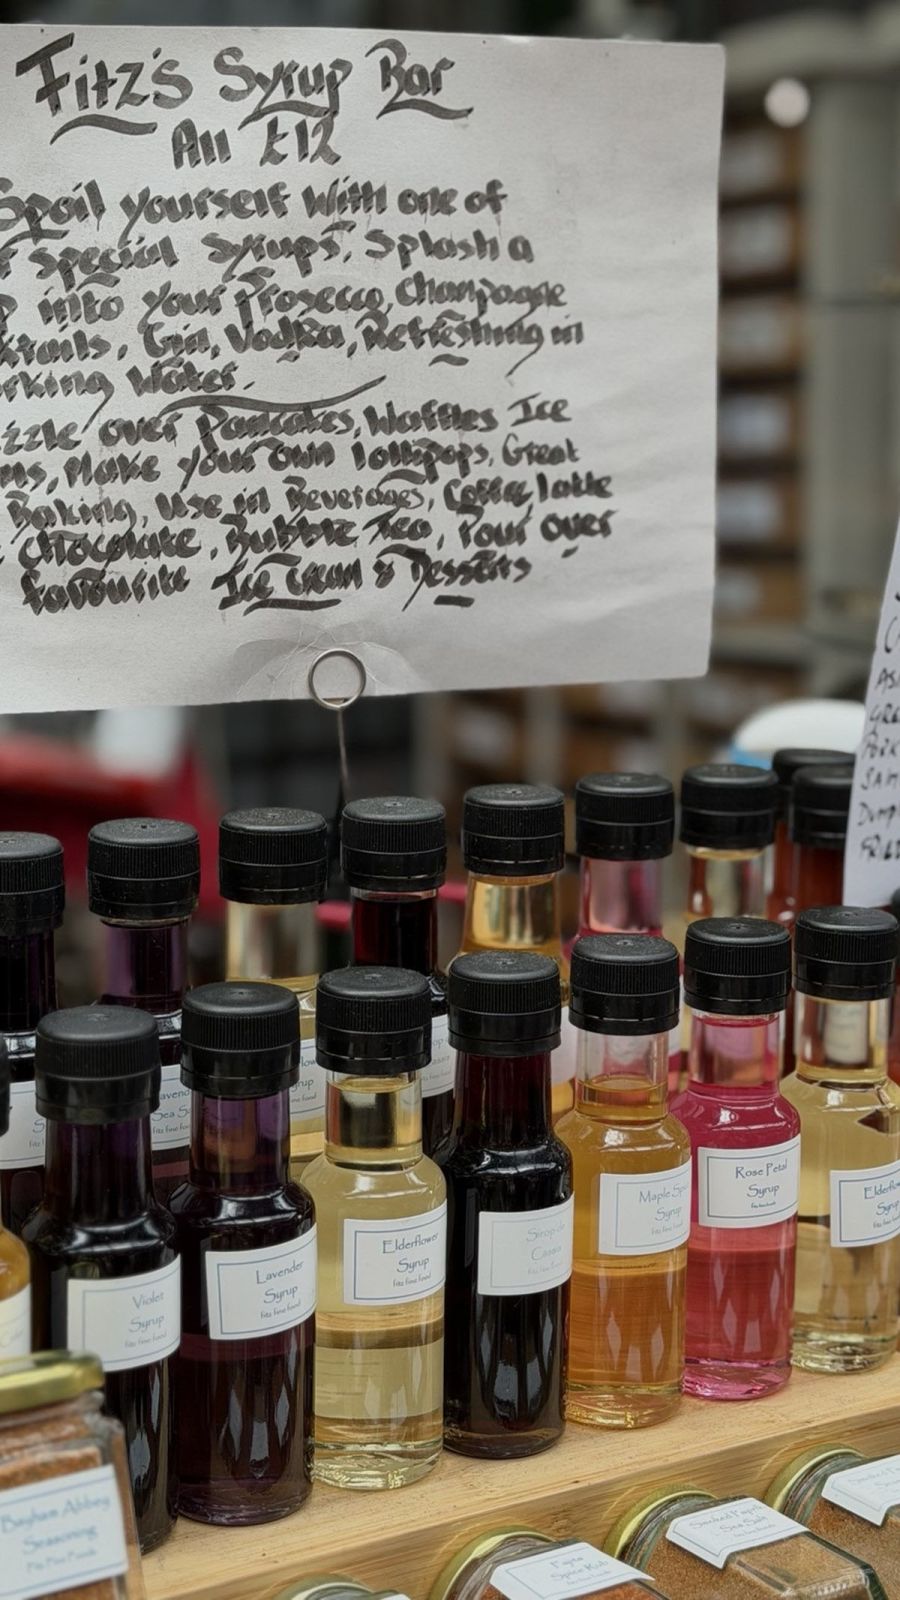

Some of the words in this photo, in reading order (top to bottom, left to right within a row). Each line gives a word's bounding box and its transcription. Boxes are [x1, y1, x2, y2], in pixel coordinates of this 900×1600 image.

[16, 32, 193, 116] Fitz's
[214, 47, 353, 122] Syrup
[365, 39, 465, 110] Bar
[172, 118, 231, 169] All
[260, 115, 341, 166] £12
[118, 181, 291, 248] yourself
[398, 186, 459, 216] one
[464, 179, 508, 216] of
[28, 236, 179, 293] special
[365, 229, 499, 270] Splash
[508, 235, 534, 263] a
[37, 286, 125, 326] into
[234, 270, 393, 328] Prosecco,
[395, 271, 567, 326] Champagne
[143, 321, 220, 359] Gin,
[224, 316, 357, 358] Vodka,
[355, 309, 544, 368] Refreshing
[550, 314, 584, 345] in
[0, 419, 82, 455] zzle
[99, 412, 183, 447] over
[196, 405, 361, 453] Pancakes,
[363, 399, 498, 437] Waffles
[507, 392, 573, 427] Ice
[63, 450, 161, 488] Make
[177, 439, 266, 492] your
[268, 441, 336, 471] own
[351, 438, 493, 484] lollipops,
[502, 433, 580, 467] Great
[234, 487, 271, 515] in
[283, 476, 434, 514] Beverages,
[537, 472, 613, 502] latte
[220, 514, 360, 556] Bubble
[362, 508, 444, 550] Tea,
[456, 504, 532, 549] Pour
[211, 558, 274, 610] Ice
[286, 557, 362, 596] Cream
[373, 558, 396, 588] &
[735, 1166, 764, 1179] Rose
[766, 1158, 788, 1177] Petal
[746, 1184, 780, 1199] Syrup
[639, 1187, 671, 1204] Maple
[655, 1207, 682, 1222] Syrup
[382, 1233, 439, 1254] Elderflower
[396, 1258, 429, 1273] Syrup
[256, 1259, 304, 1285] Lavender
[263, 1286, 298, 1304] Syrup
[129, 1315, 165, 1333] Syrup
